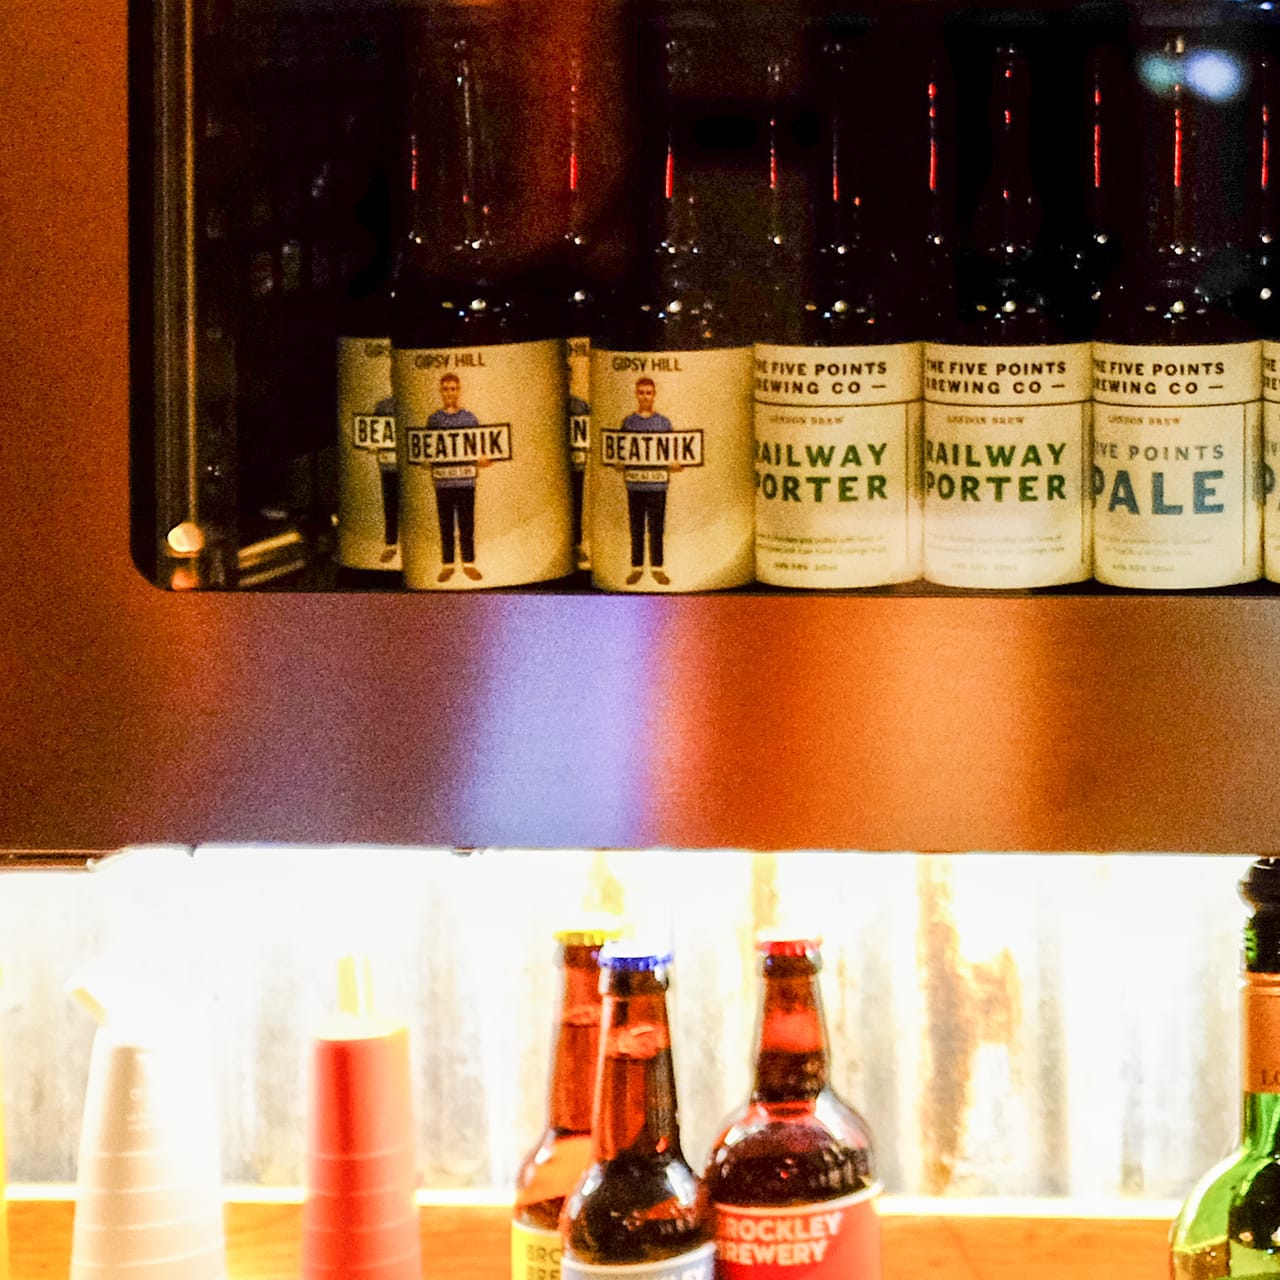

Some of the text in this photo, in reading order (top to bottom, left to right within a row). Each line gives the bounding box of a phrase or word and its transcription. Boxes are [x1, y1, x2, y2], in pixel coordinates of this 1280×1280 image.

[414, 352, 486, 370] GIPSY HILL
[612, 356, 683, 372] GIPSY HILL
[771, 361, 888, 377] FIVE POINTS
[948, 362, 988, 377] FIVE
[995, 361, 1066, 377] POINTS
[1110, 361, 1225, 377] FIVE POINTS
[831, 381, 860, 396] CO
[1012, 380, 1042, 395] CO
[1168, 381, 1198, 396] CO
[411, 431, 503, 459] BEATNIK
[605, 434, 696, 462] BEATNIK
[1127, 444, 1225, 462] POINTS
[1092, 463, 1225, 517] PALE
[722, 1212, 843, 1241] ROCKLEY
